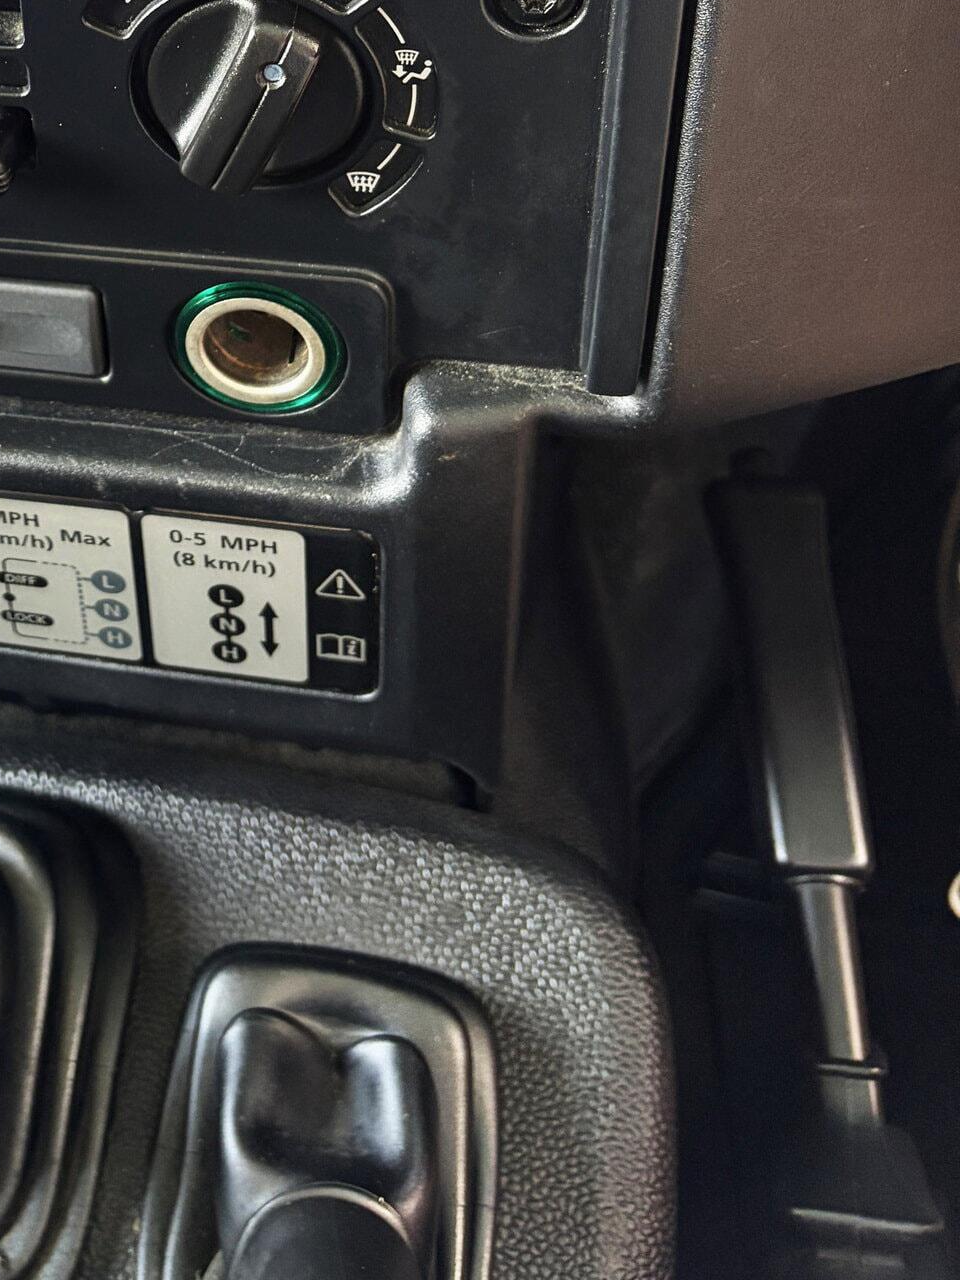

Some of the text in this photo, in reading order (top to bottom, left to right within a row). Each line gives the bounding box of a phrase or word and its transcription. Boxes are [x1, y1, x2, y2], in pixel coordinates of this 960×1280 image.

[60, 528, 112, 548] Max
[169, 528, 278, 555] 0-5 MPH
[173, 550, 276, 578] (8 km/h)
[4, 573, 38, 586] DIFF
[101, 575, 115, 590] L
[219, 588, 233, 604] L
[5, 610, 49, 626] LOCK
[103, 603, 122, 619] N
[218, 617, 238, 633] N
[106, 630, 124, 646] H
[221, 645, 239, 661] H
